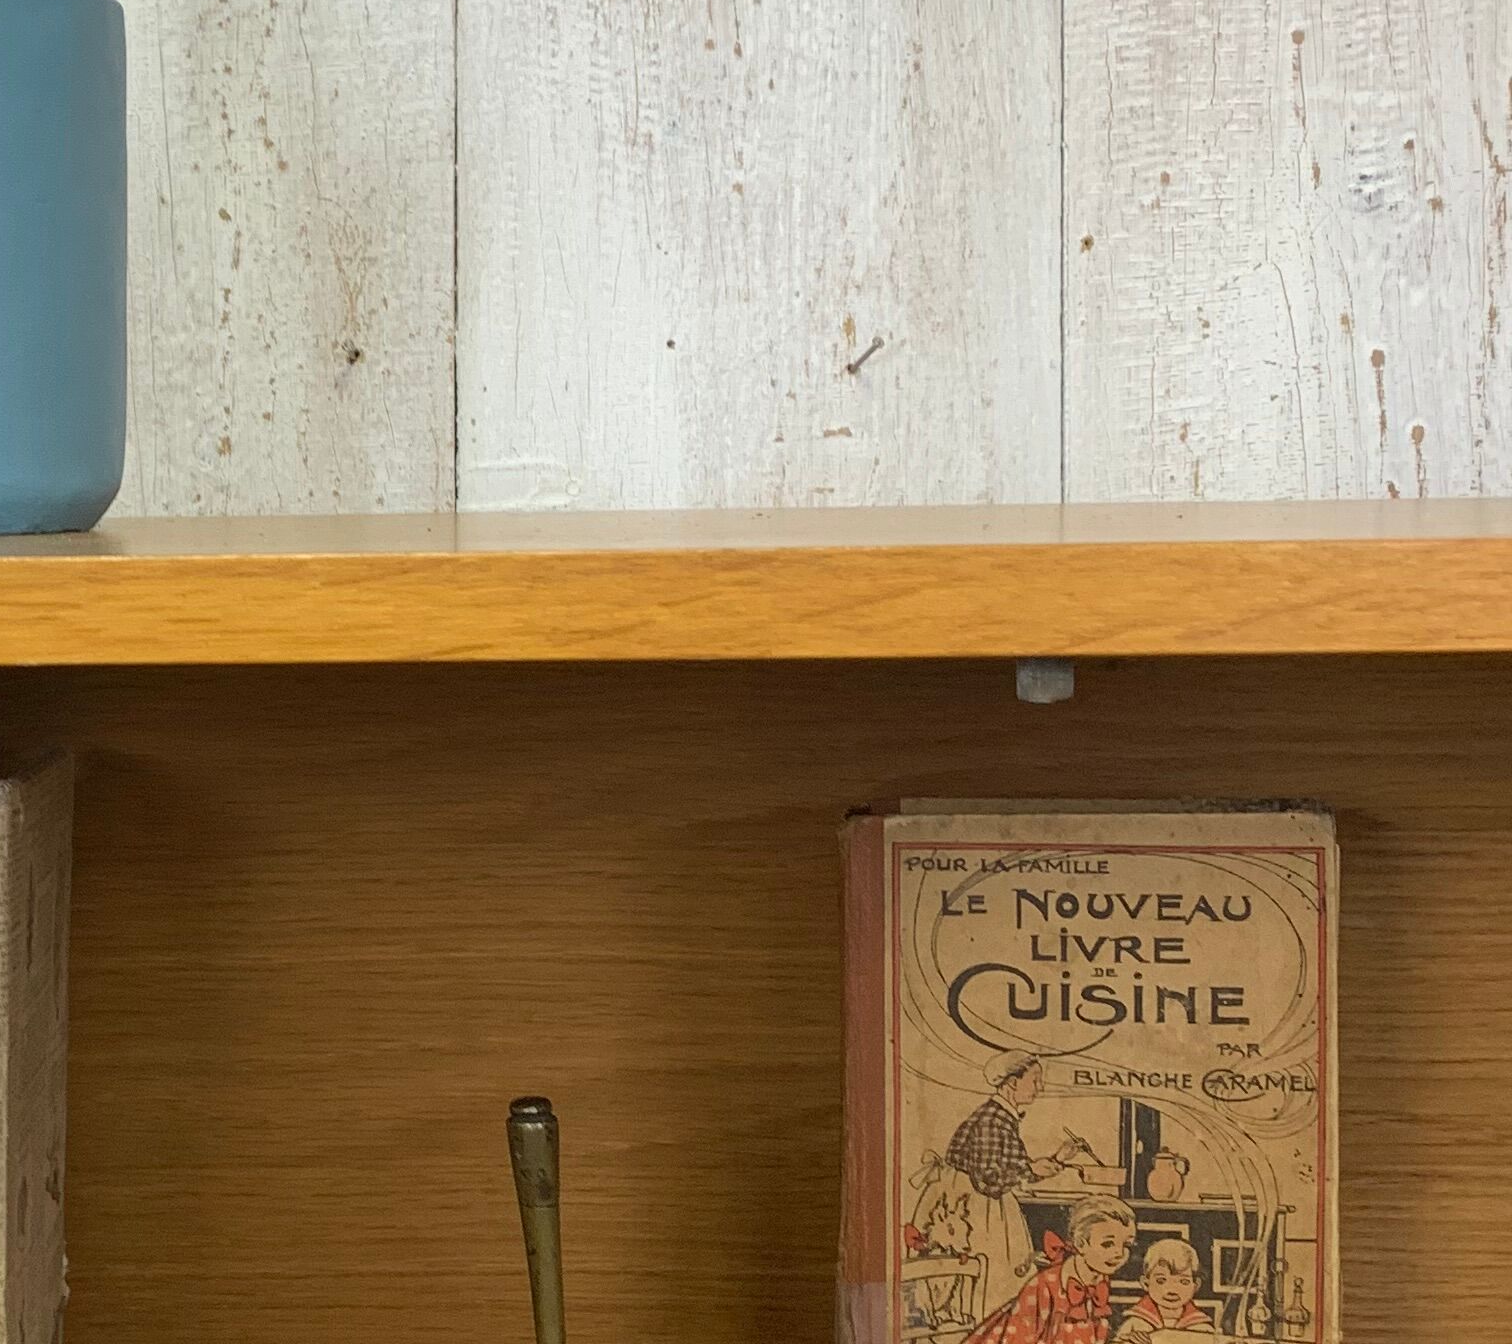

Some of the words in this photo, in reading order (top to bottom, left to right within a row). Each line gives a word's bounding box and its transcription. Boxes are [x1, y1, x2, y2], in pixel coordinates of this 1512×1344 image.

[904, 856, 968, 872] POUR
[980, 858, 1010, 873] LA
[1018, 855, 1110, 874] FAMILLE
[940, 889, 988, 916] LE
[1012, 888, 1253, 929] NOUVEAU
[1031, 927, 1191, 964] LIVRE
[1090, 967, 1118, 978] DE
[947, 962, 1251, 1056] CUISINE
[1216, 1042, 1262, 1058] PAR
[1073, 1069, 1193, 1089] BLANCHE
[1201, 1068, 1317, 1102] CARAMEL
